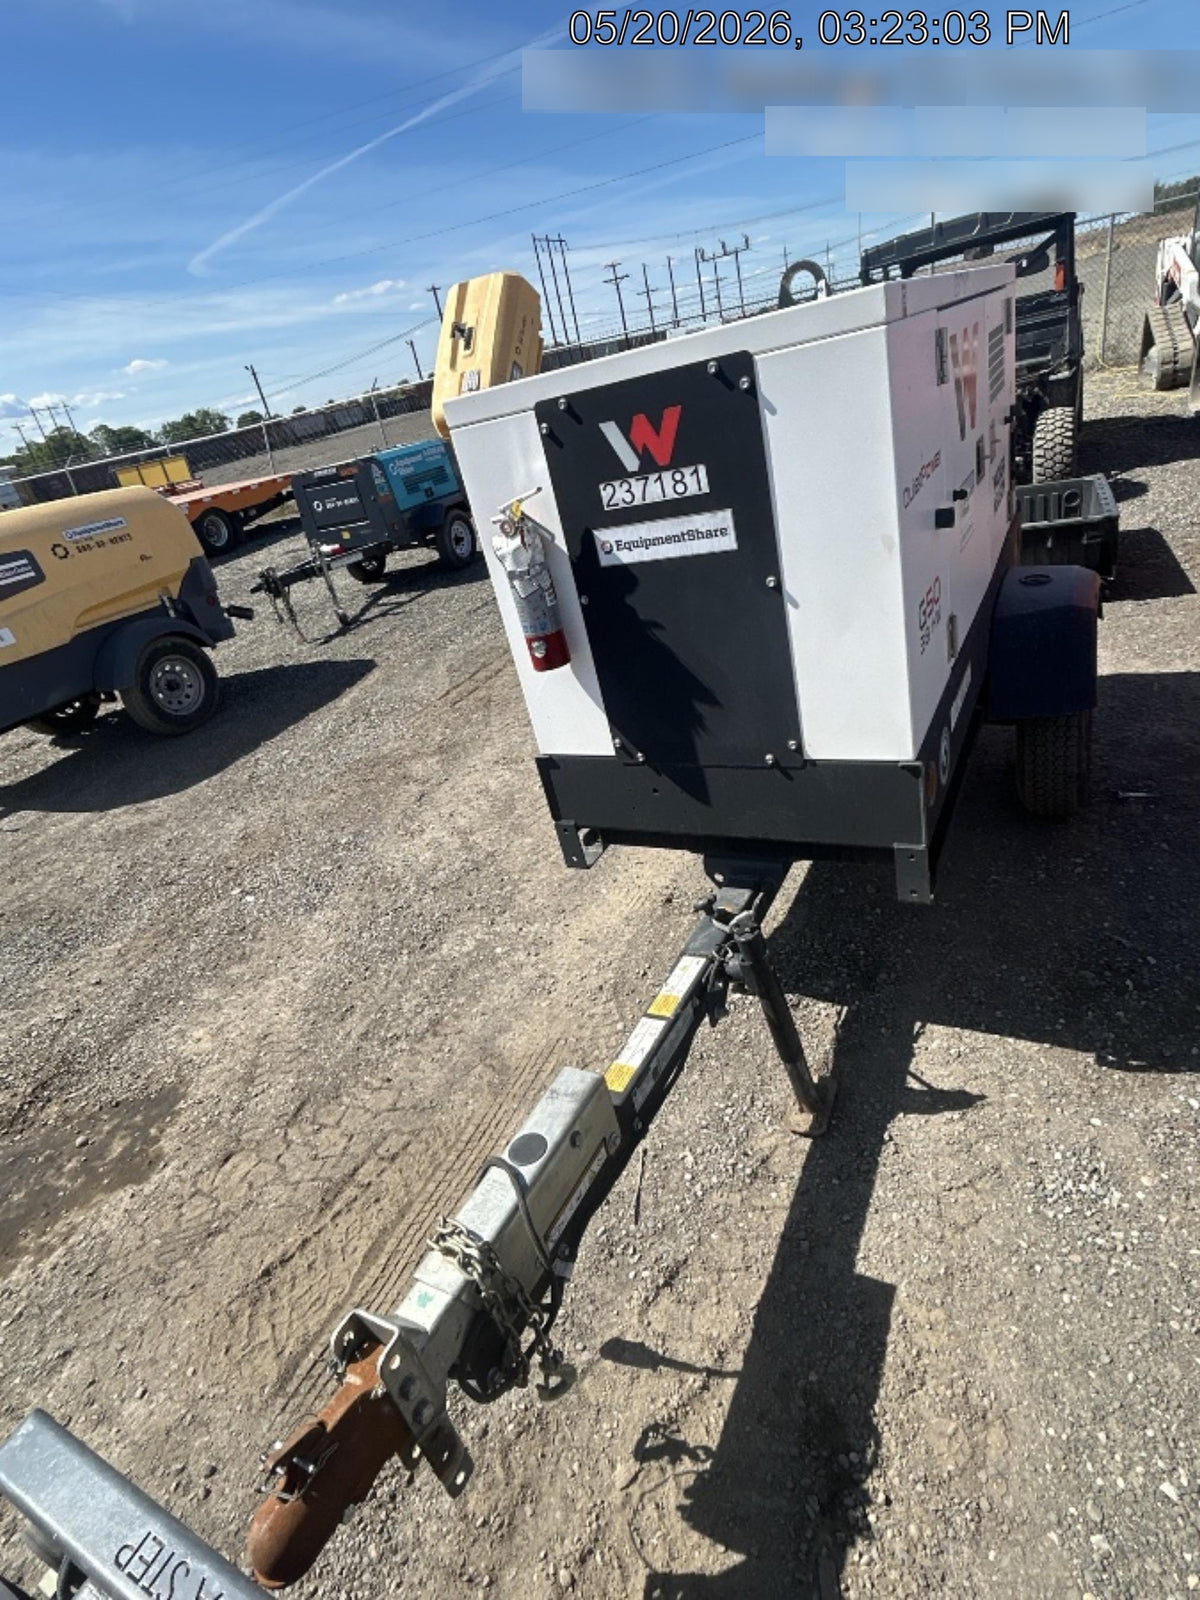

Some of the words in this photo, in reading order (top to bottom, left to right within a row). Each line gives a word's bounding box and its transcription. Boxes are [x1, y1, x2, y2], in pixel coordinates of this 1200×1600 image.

[602, 466, 703, 509] 237181
[614, 526, 729, 552] EquipmentShare
[114, 1530, 191, 1600] STEP
